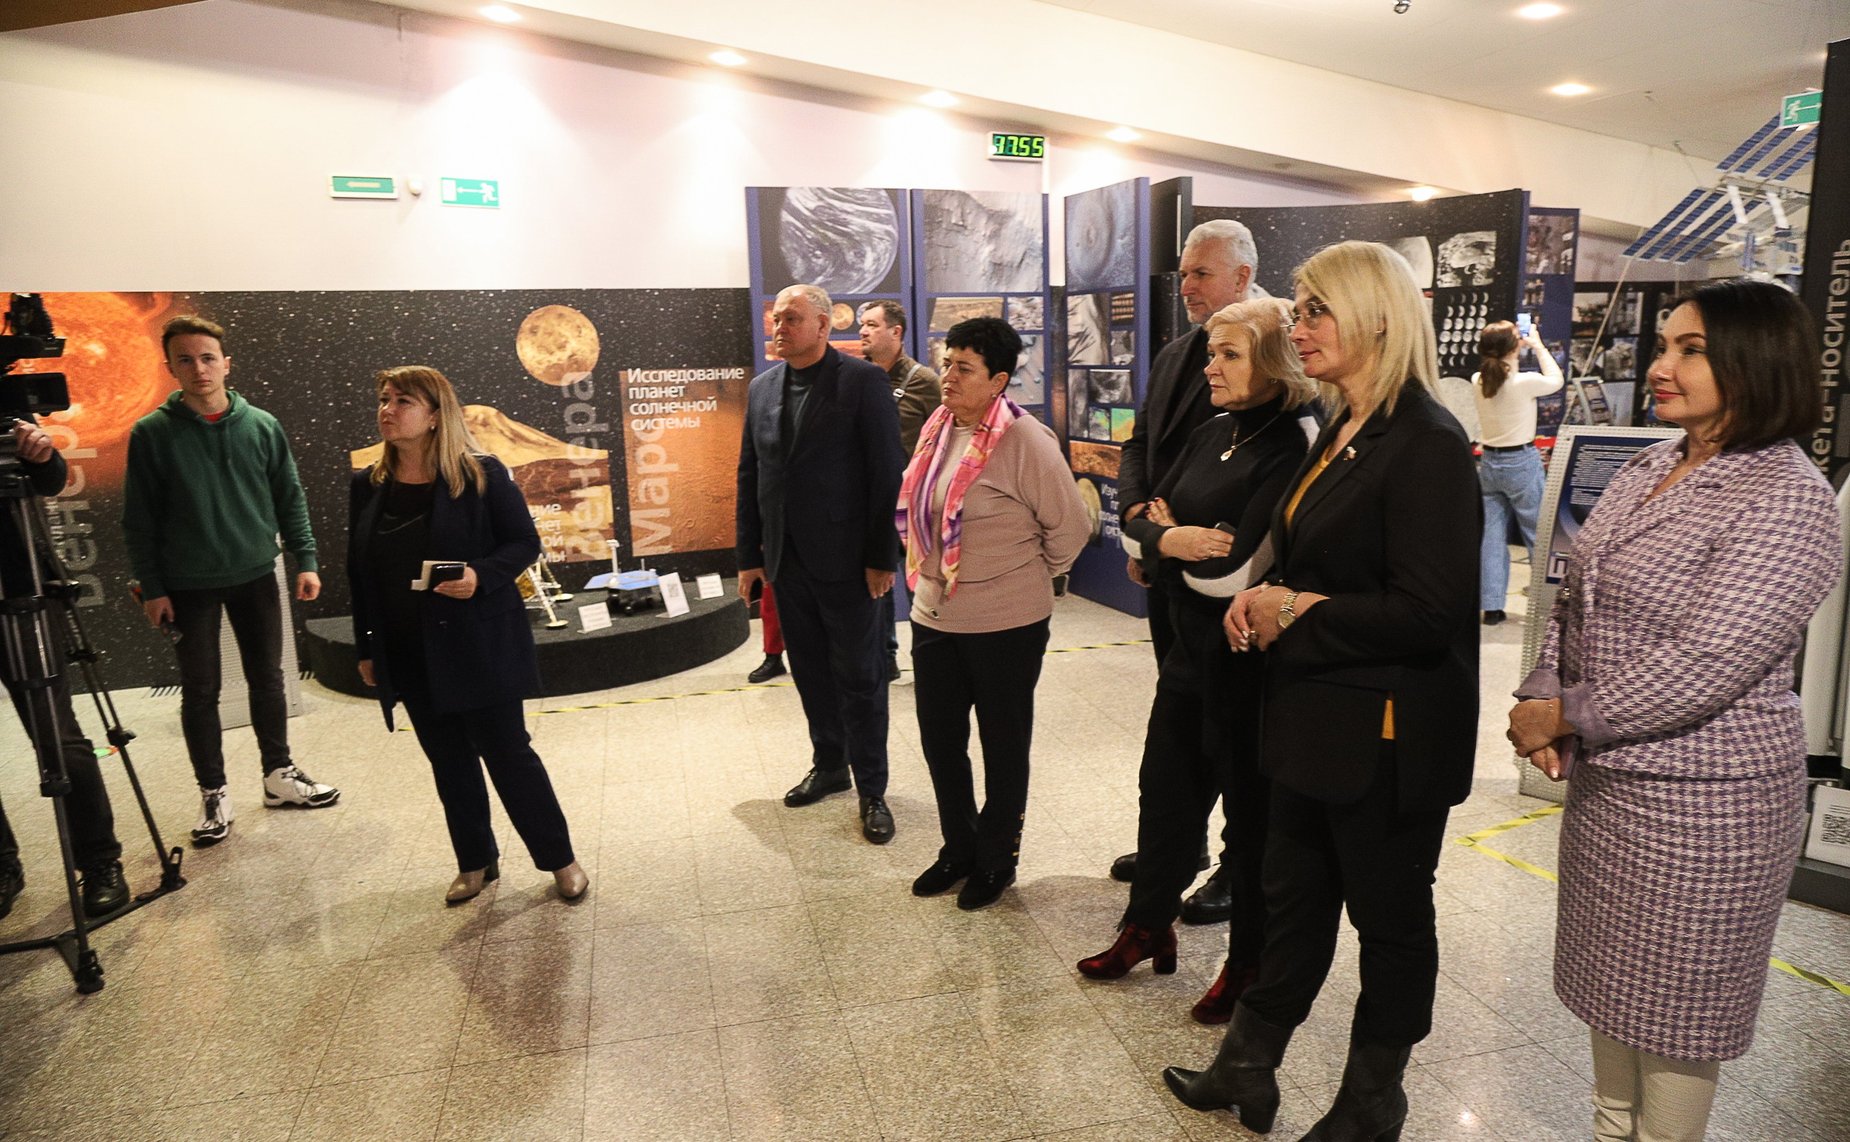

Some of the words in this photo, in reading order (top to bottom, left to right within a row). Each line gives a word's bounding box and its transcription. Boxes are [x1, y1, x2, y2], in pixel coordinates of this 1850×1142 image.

[1811, 239, 1850, 474] кета-носитель
[627, 366, 745, 384] Исследование
[628, 385, 685, 399] планет
[629, 396, 718, 415] солнечной
[631, 416, 701, 431] системы
[561, 371, 609, 558] Венера
[629, 426, 680, 556] Марс
